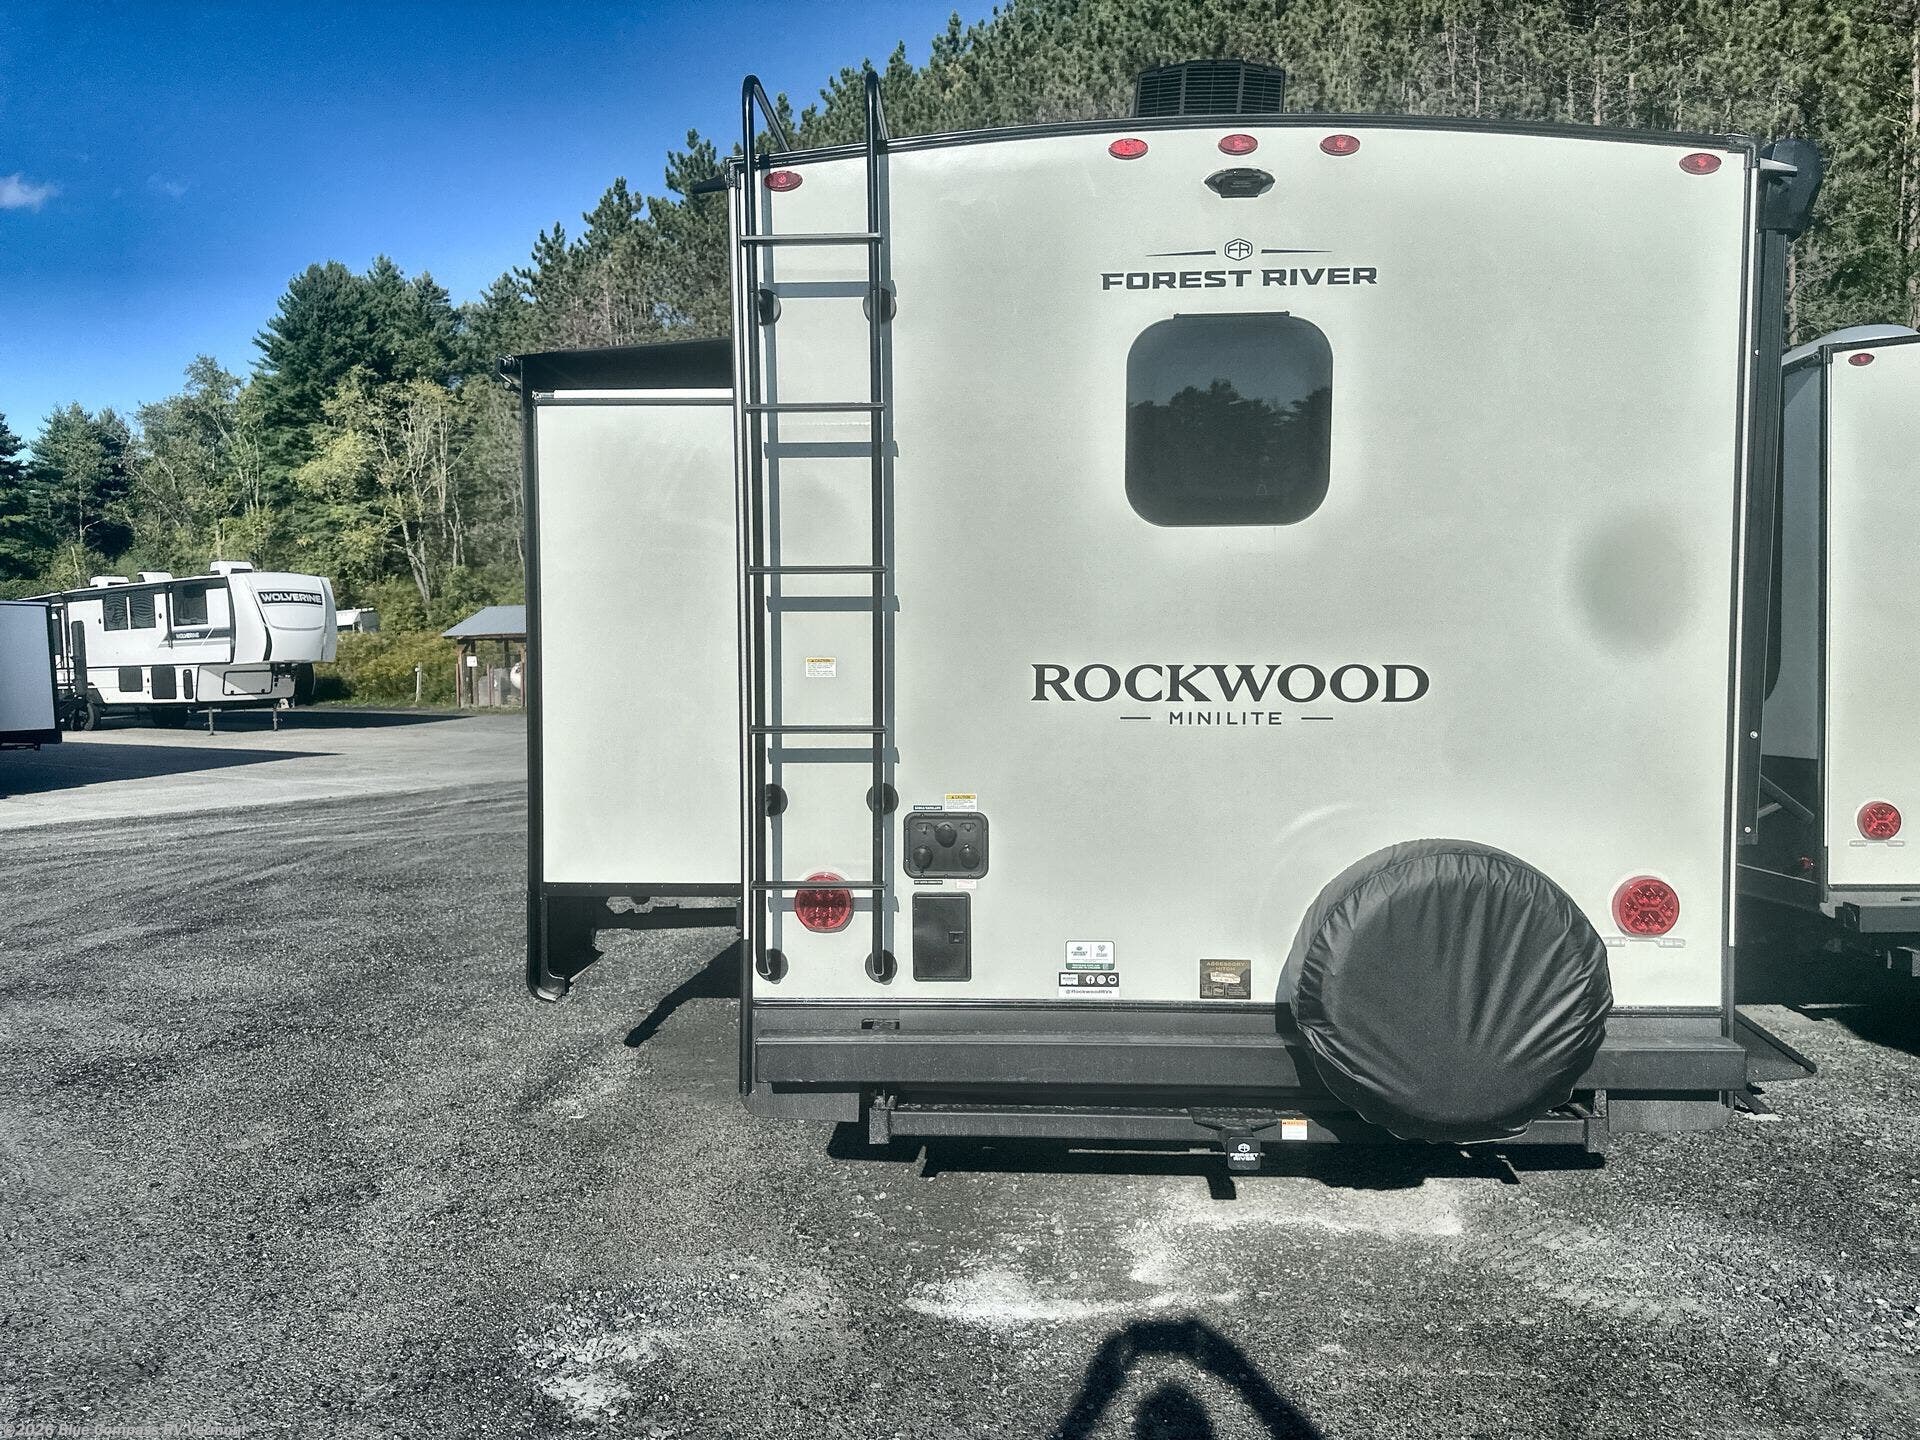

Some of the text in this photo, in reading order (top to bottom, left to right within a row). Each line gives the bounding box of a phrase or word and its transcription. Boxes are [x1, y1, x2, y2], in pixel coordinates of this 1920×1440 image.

[1101, 267, 1378, 290] FOREST RIVER
[259, 592, 322, 604] WOLVERINE
[1031, 663, 1430, 703] ROCKWOOD
[1169, 712, 1282, 726] MINILITE
